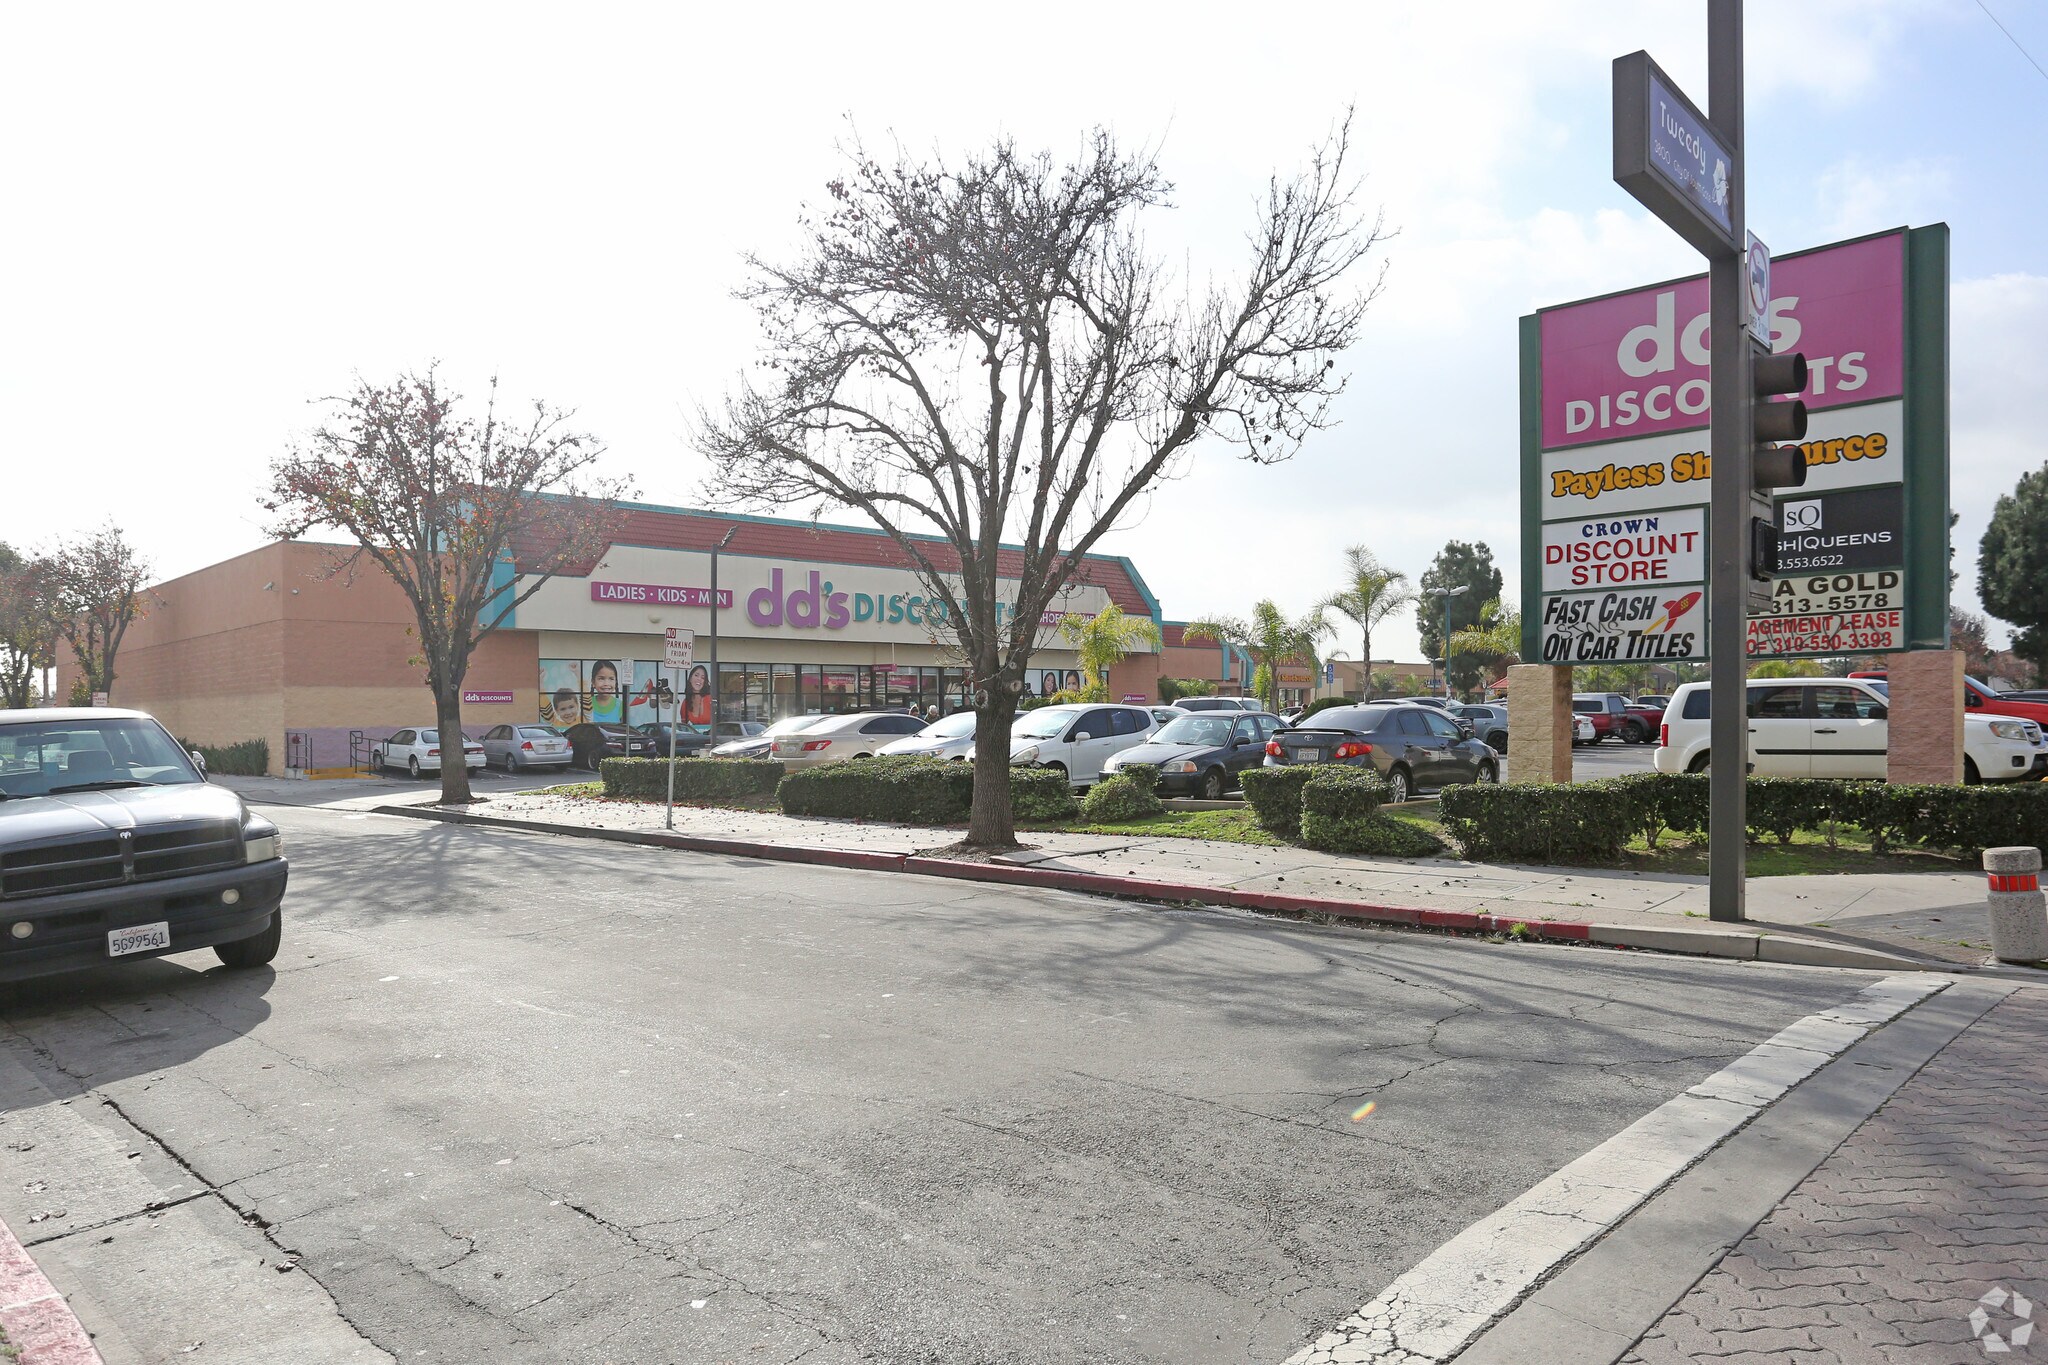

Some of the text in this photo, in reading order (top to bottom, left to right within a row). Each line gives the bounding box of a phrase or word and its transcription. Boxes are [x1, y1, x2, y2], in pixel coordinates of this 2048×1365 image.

[1660, 101, 1706, 175] Tweedy
[1565, 351, 1869, 435] DISCOTS
[1551, 463, 1666, 500] Payless
[1582, 517, 1659, 538] CROWN
[1546, 531, 1699, 565] DISCOUNT
[1571, 558, 1668, 586] STORE
[1807, 571, 1899, 595] GOLD
[600, 585, 727, 606] LADIES KIDS MN
[747, 567, 851, 630] dd's
[1543, 592, 1658, 625] FAST CASH
[1841, 611, 1900, 630] LEASE
[666, 628, 676, 638] NO
[666, 640, 692, 650] PARKING
[1543, 629, 1696, 661] ON CAR TITLES
[1773, 631, 1893, 654] 310-550-3393
[671, 650, 688, 658] FRIDAY
[112, 931, 166, 952] 5G99561
